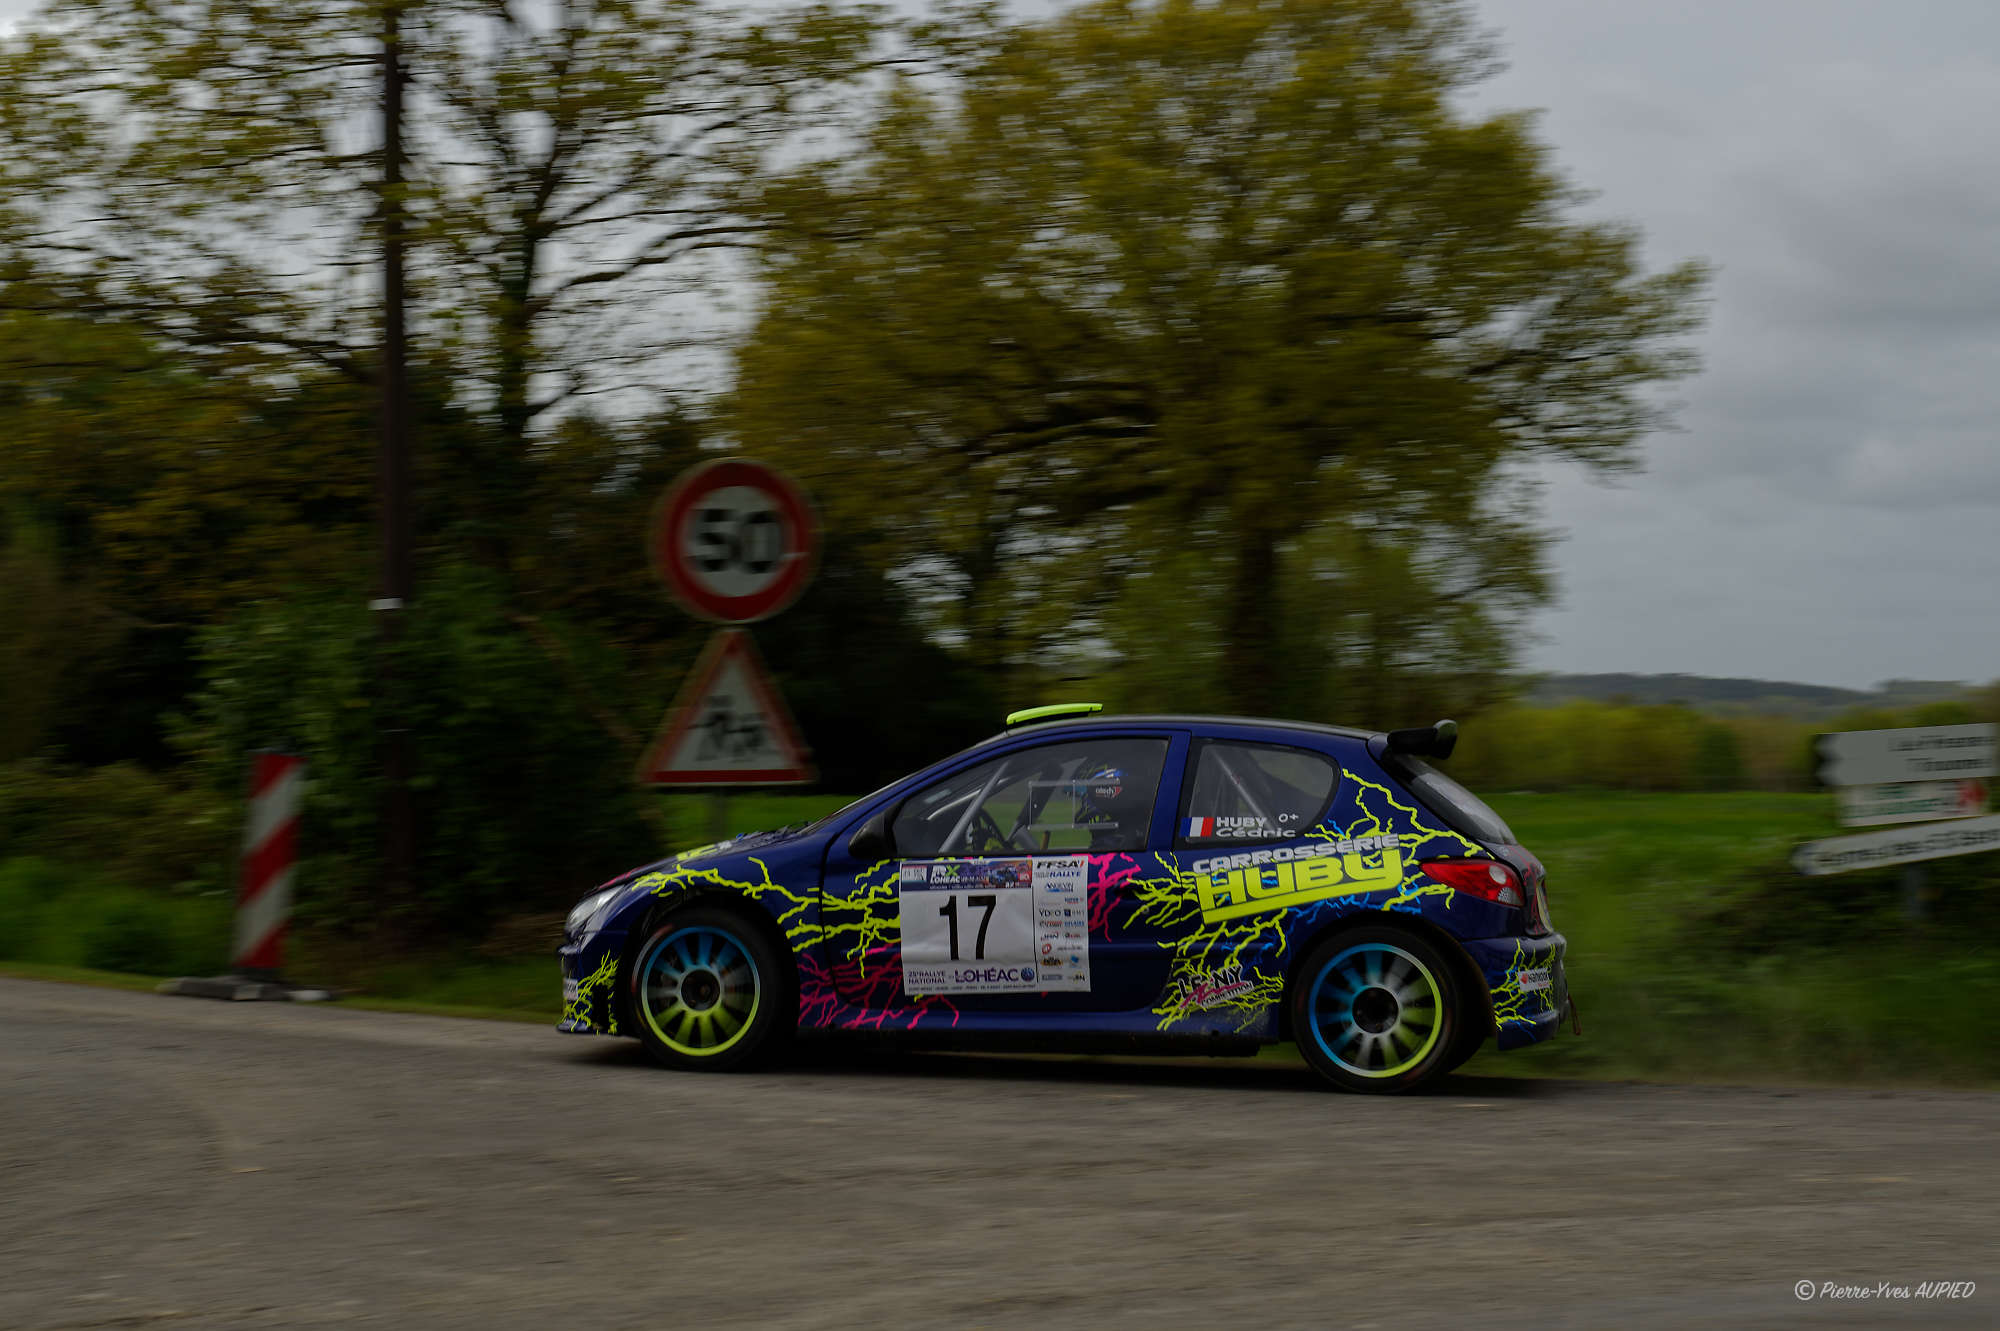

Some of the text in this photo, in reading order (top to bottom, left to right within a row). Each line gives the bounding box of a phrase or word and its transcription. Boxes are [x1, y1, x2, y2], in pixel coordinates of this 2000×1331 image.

[694, 508, 785, 574] 50
[1215, 827, 1297, 838] Cédric
[1216, 816, 1268, 828] HUBY
[1036, 860, 1079, 869] FFSA
[1193, 833, 1400, 873] CARROSSERIE
[1196, 849, 1404, 914] HUBY
[939, 895, 997, 961] 17
[954, 967, 1019, 983] LOHÉAC
